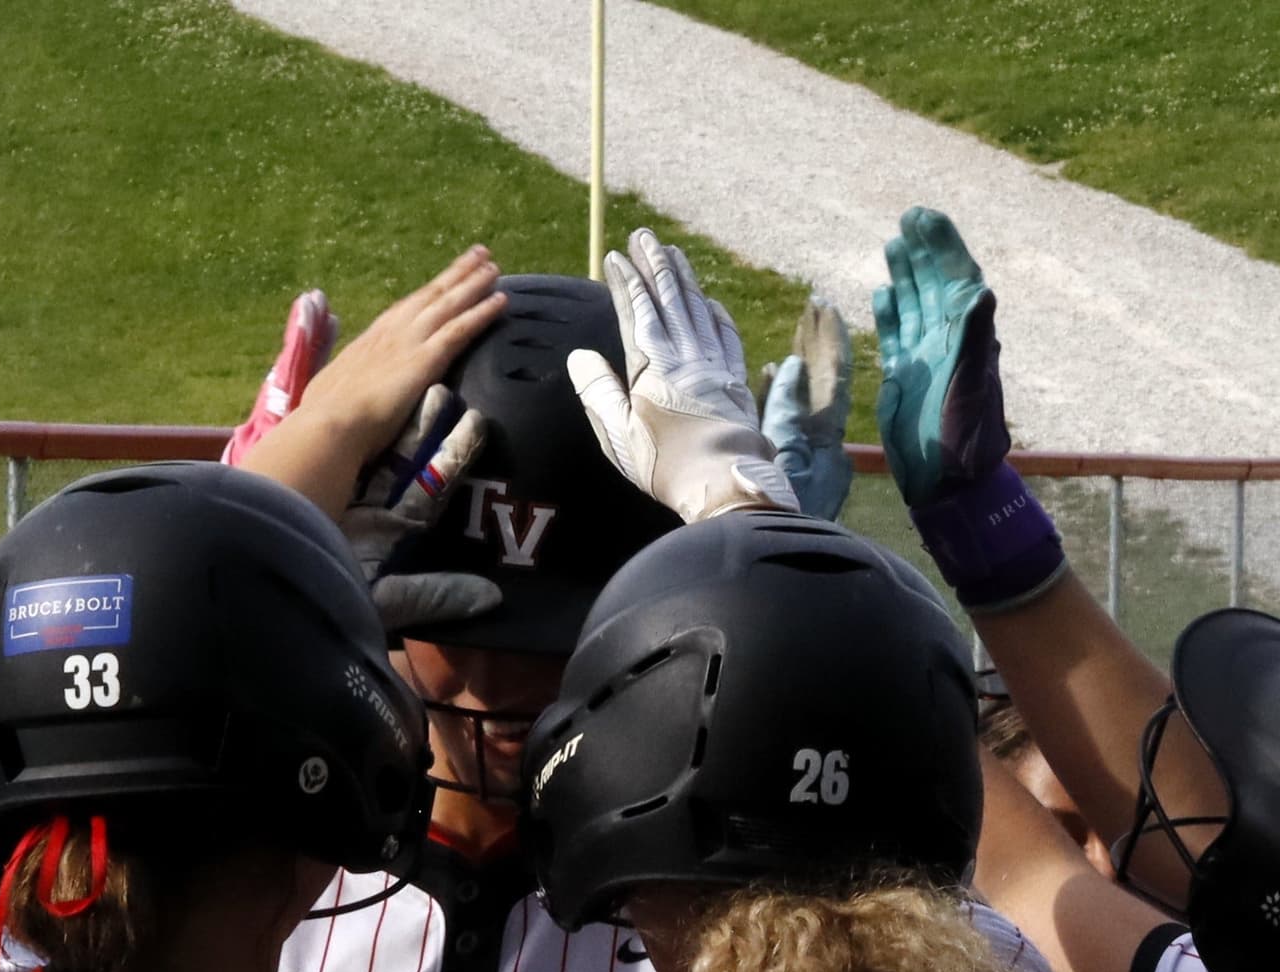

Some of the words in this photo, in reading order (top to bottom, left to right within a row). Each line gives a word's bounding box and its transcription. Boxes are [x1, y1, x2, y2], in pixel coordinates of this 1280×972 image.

[463, 478, 557, 567] TV
[7, 600, 62, 622] BRUCE
[74, 596, 125, 613] BOLT
[63, 652, 120, 710] 33
[789, 748, 850, 805] 26
